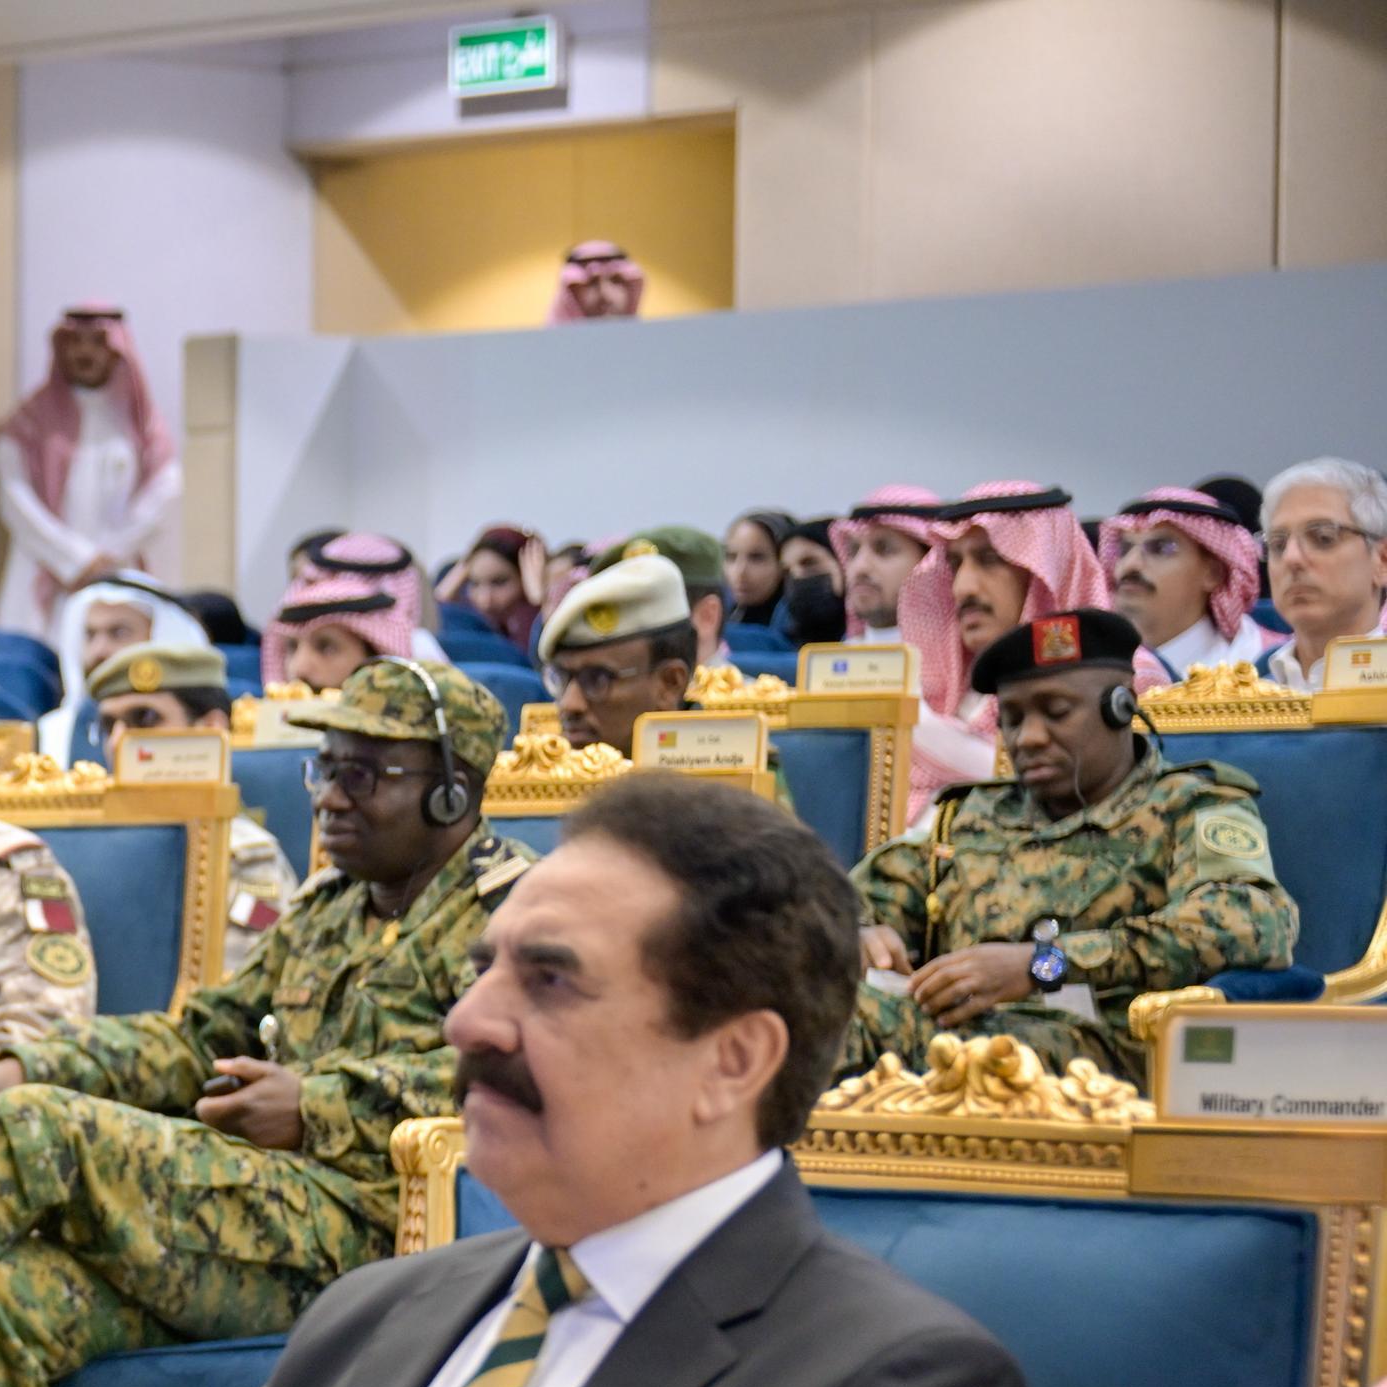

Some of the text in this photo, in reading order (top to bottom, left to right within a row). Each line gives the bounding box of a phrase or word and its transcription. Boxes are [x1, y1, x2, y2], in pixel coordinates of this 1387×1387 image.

[455, 43, 499, 82] EXIT
[1200, 1092, 1386, 1117] Military Commander
